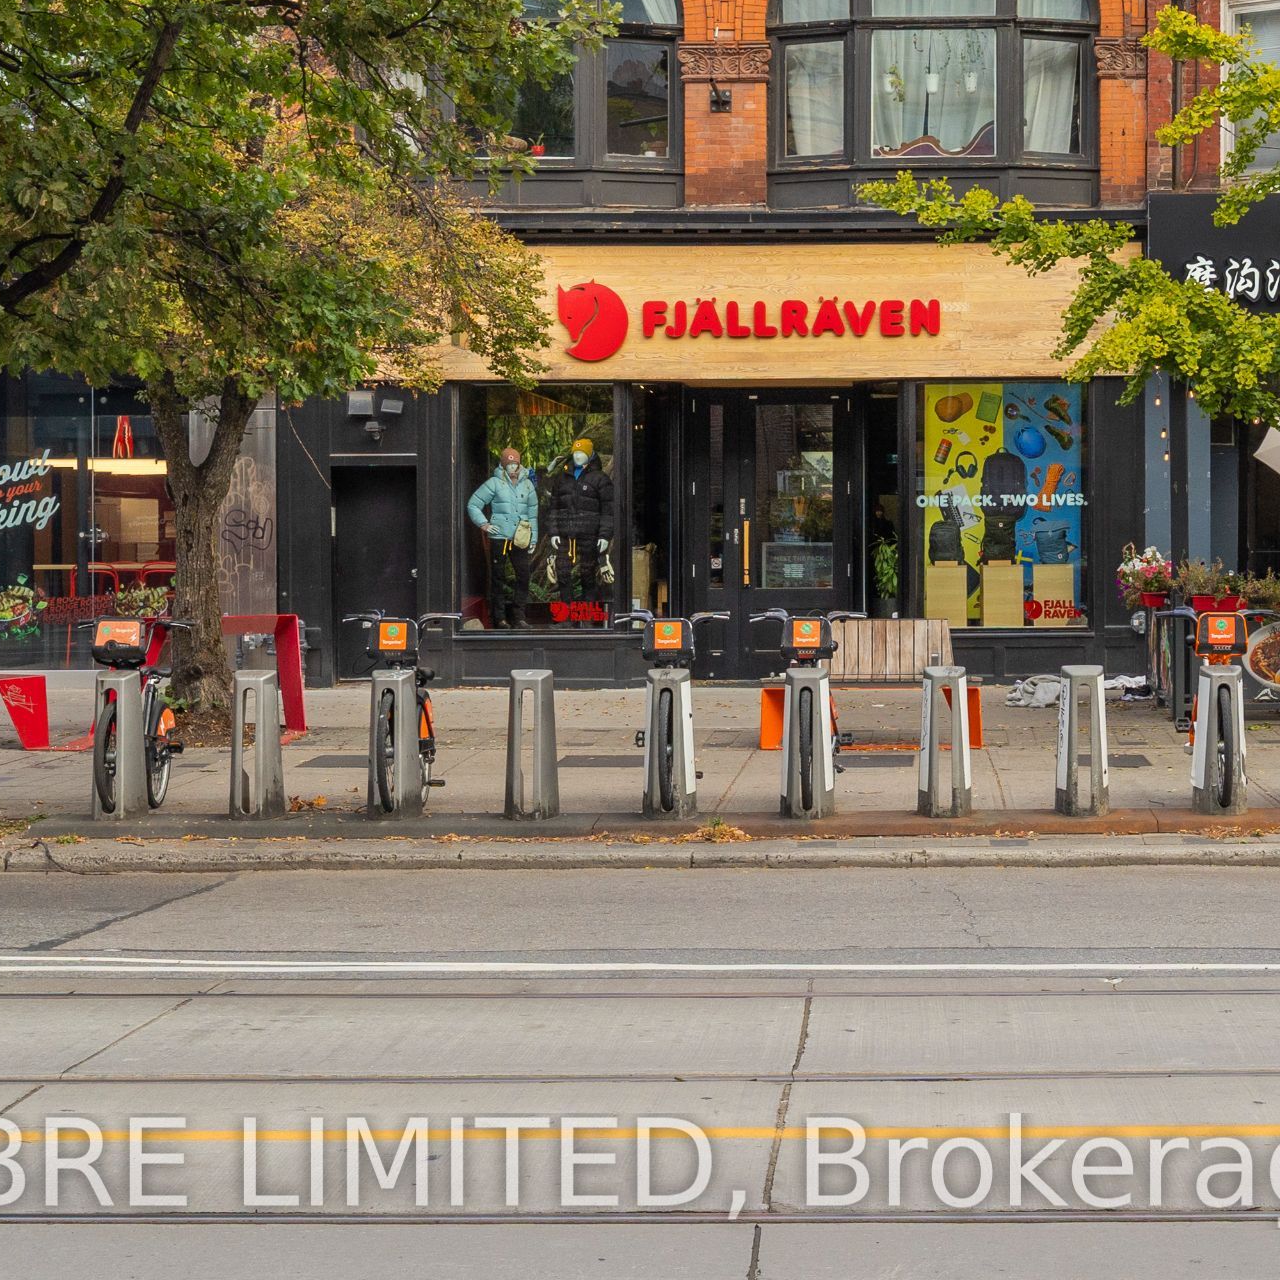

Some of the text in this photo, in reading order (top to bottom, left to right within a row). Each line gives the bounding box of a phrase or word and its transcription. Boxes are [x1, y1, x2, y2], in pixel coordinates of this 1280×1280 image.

[641, 295, 941, 338] FJÄLLRÄVEN
[4, 480, 43, 503] your
[916, 493, 1088, 508] ONE PACK. TWO LIVES.
